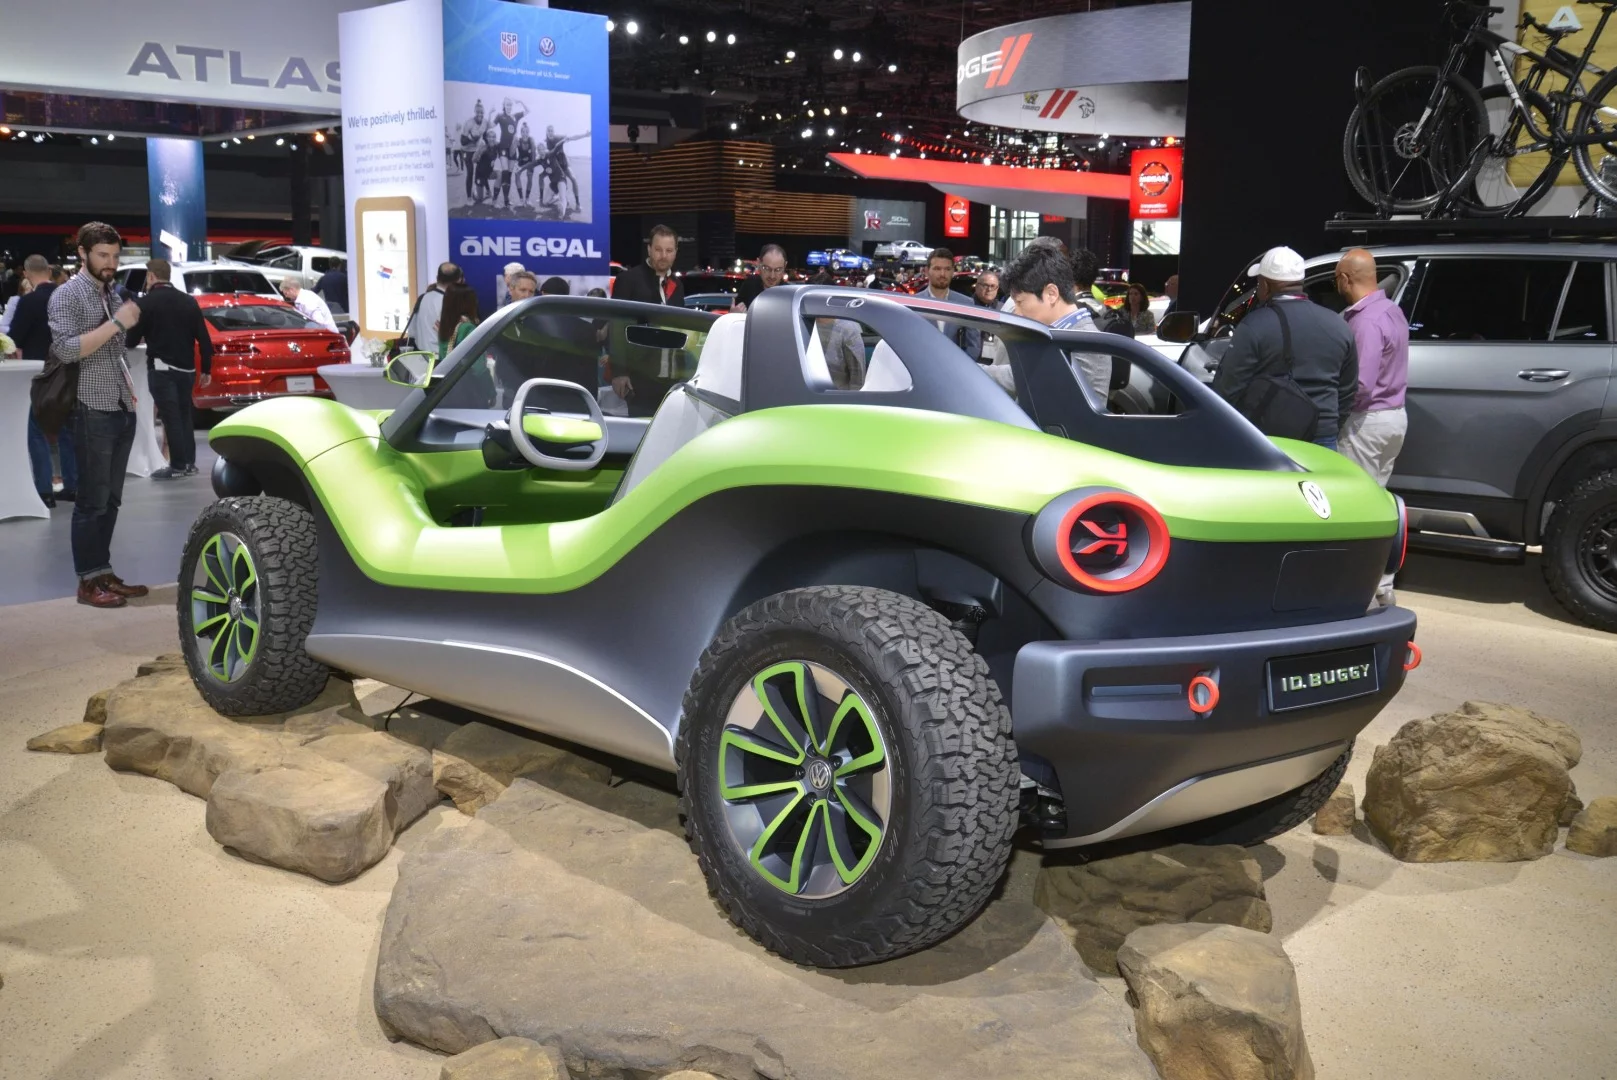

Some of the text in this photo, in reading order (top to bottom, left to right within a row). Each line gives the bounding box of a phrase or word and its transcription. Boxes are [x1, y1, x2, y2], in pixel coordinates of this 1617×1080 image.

[501, 33, 517, 45] USA
[488, 64, 516, 75] Presenting
[517, 68, 536, 76] Partner
[1492, 49, 1523, 108] TREK
[348, 105, 438, 129] We're positively thrilled.
[526, 237, 602, 258] GOAL
